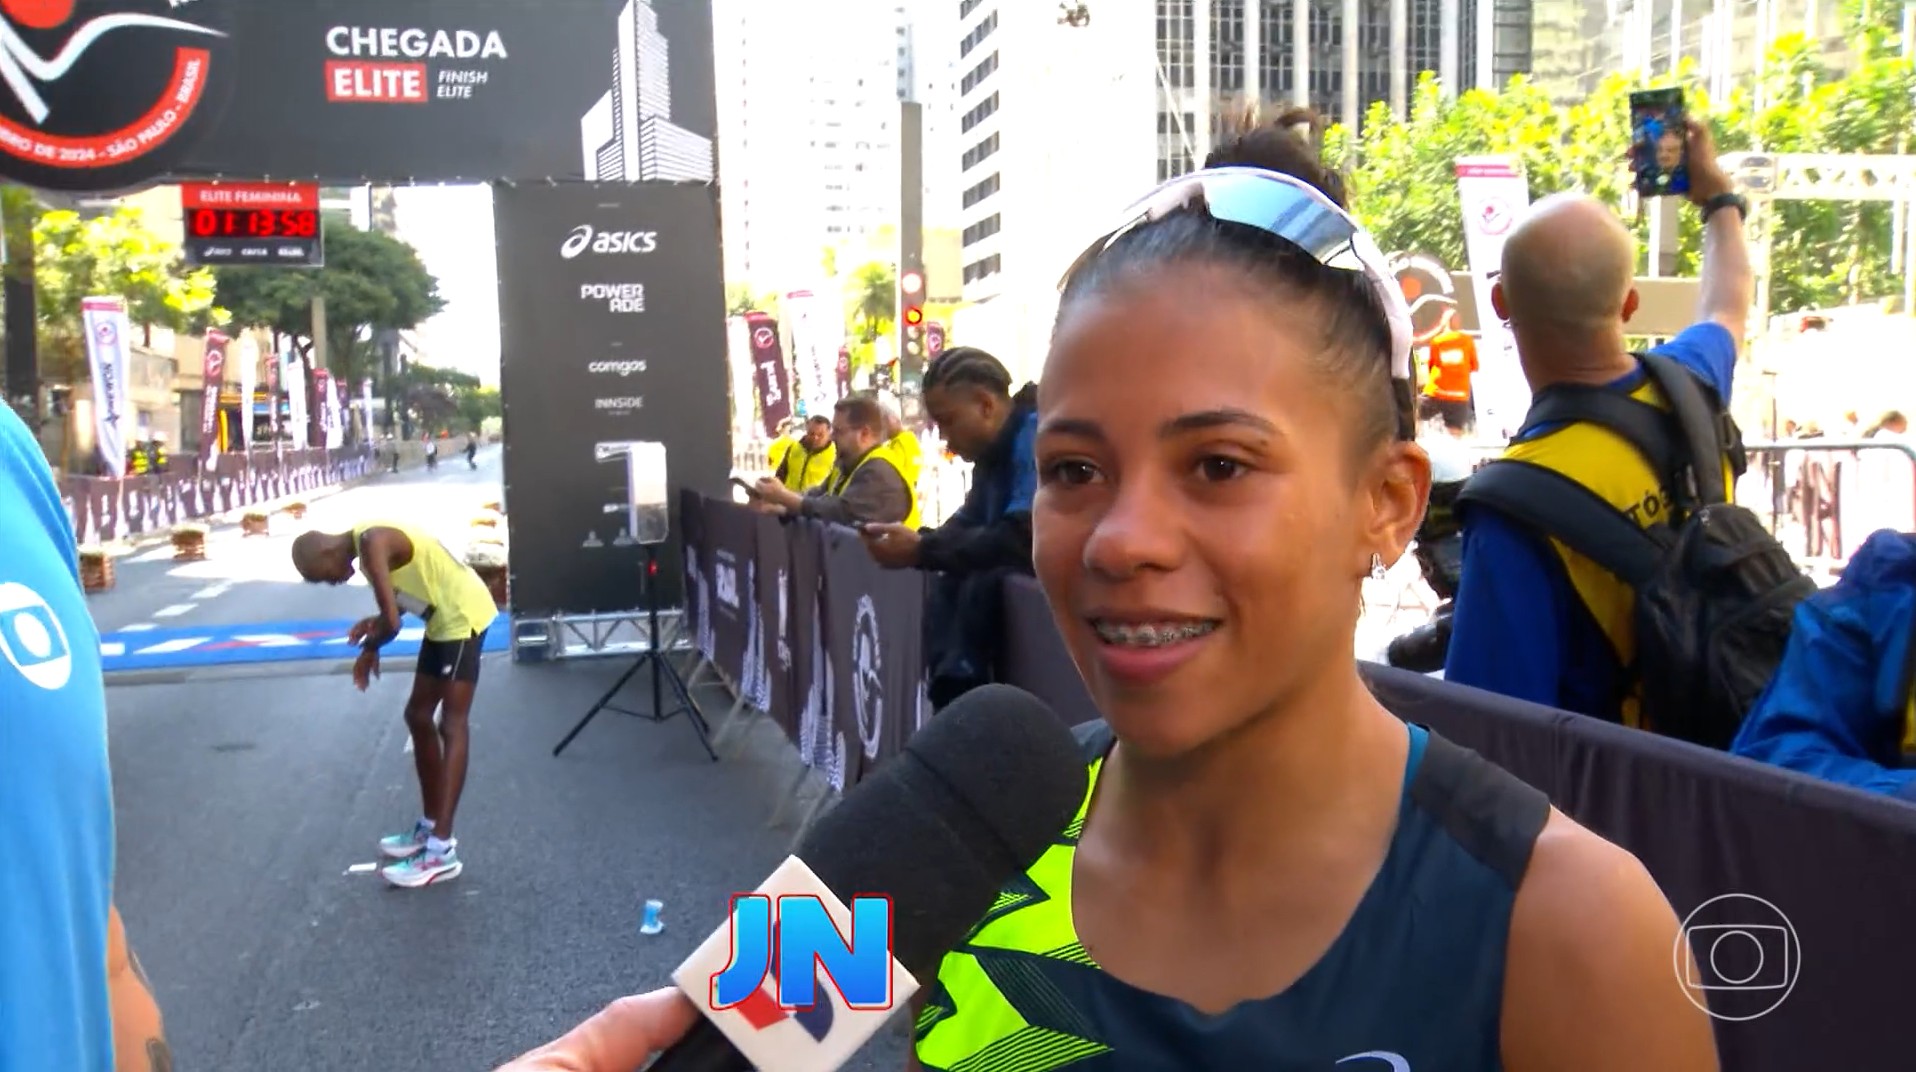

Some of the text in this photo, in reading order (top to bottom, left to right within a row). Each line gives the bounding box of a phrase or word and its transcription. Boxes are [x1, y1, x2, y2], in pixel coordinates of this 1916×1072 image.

[326, 26, 508, 59] CHEGADA
[333, 68, 423, 99] ELITE
[438, 70, 488, 84] FINISH
[437, 84, 472, 99] ELITE
[137, 110, 177, 143] PAULO
[177, 59, 201, 102] BRASIL
[200, 190, 302, 202] ELITE FEMININA
[592, 231, 657, 253] asics
[581, 284, 644, 299] POWER
[609, 299, 644, 313] ADE
